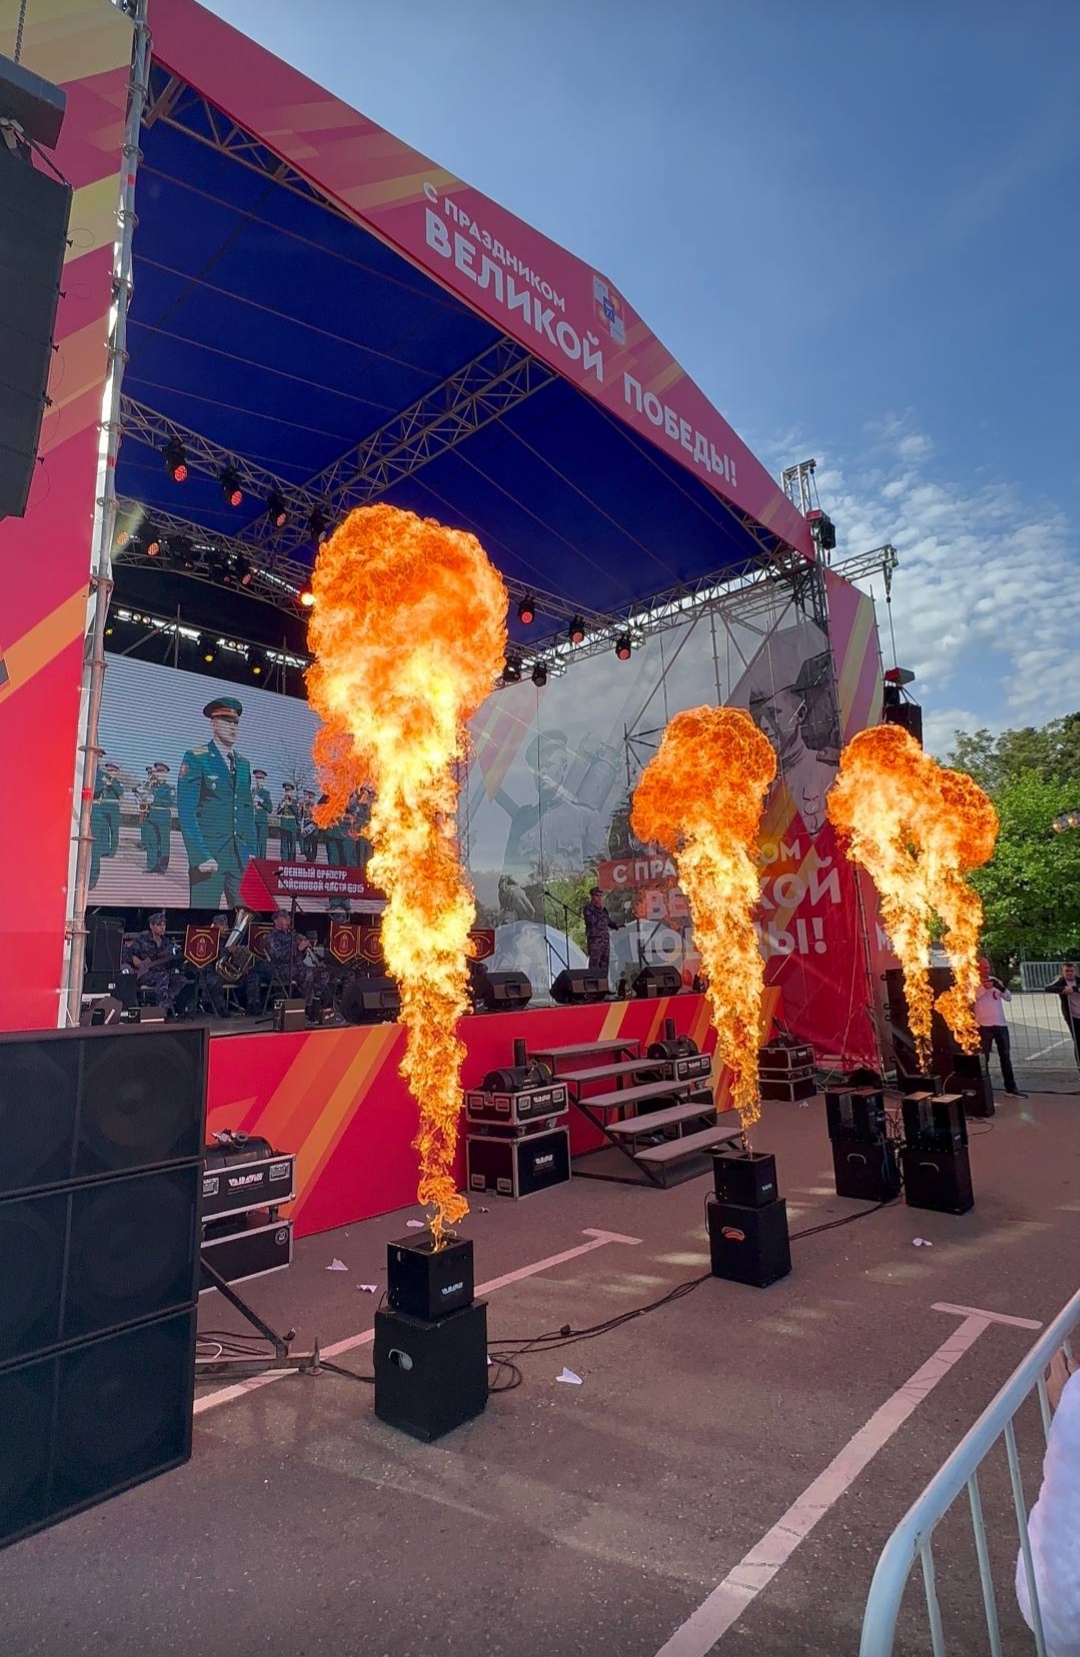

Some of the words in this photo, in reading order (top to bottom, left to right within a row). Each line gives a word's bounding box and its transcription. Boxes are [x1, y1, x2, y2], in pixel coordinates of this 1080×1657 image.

[423, 181, 438, 203] С
[444, 197, 565, 313] ПРАЗДНИКОМ
[425, 207, 603, 382] ВЕЛИКОЙ
[624, 372, 738, 488] ПОБЕДЫ!
[612, 864, 628, 883] С
